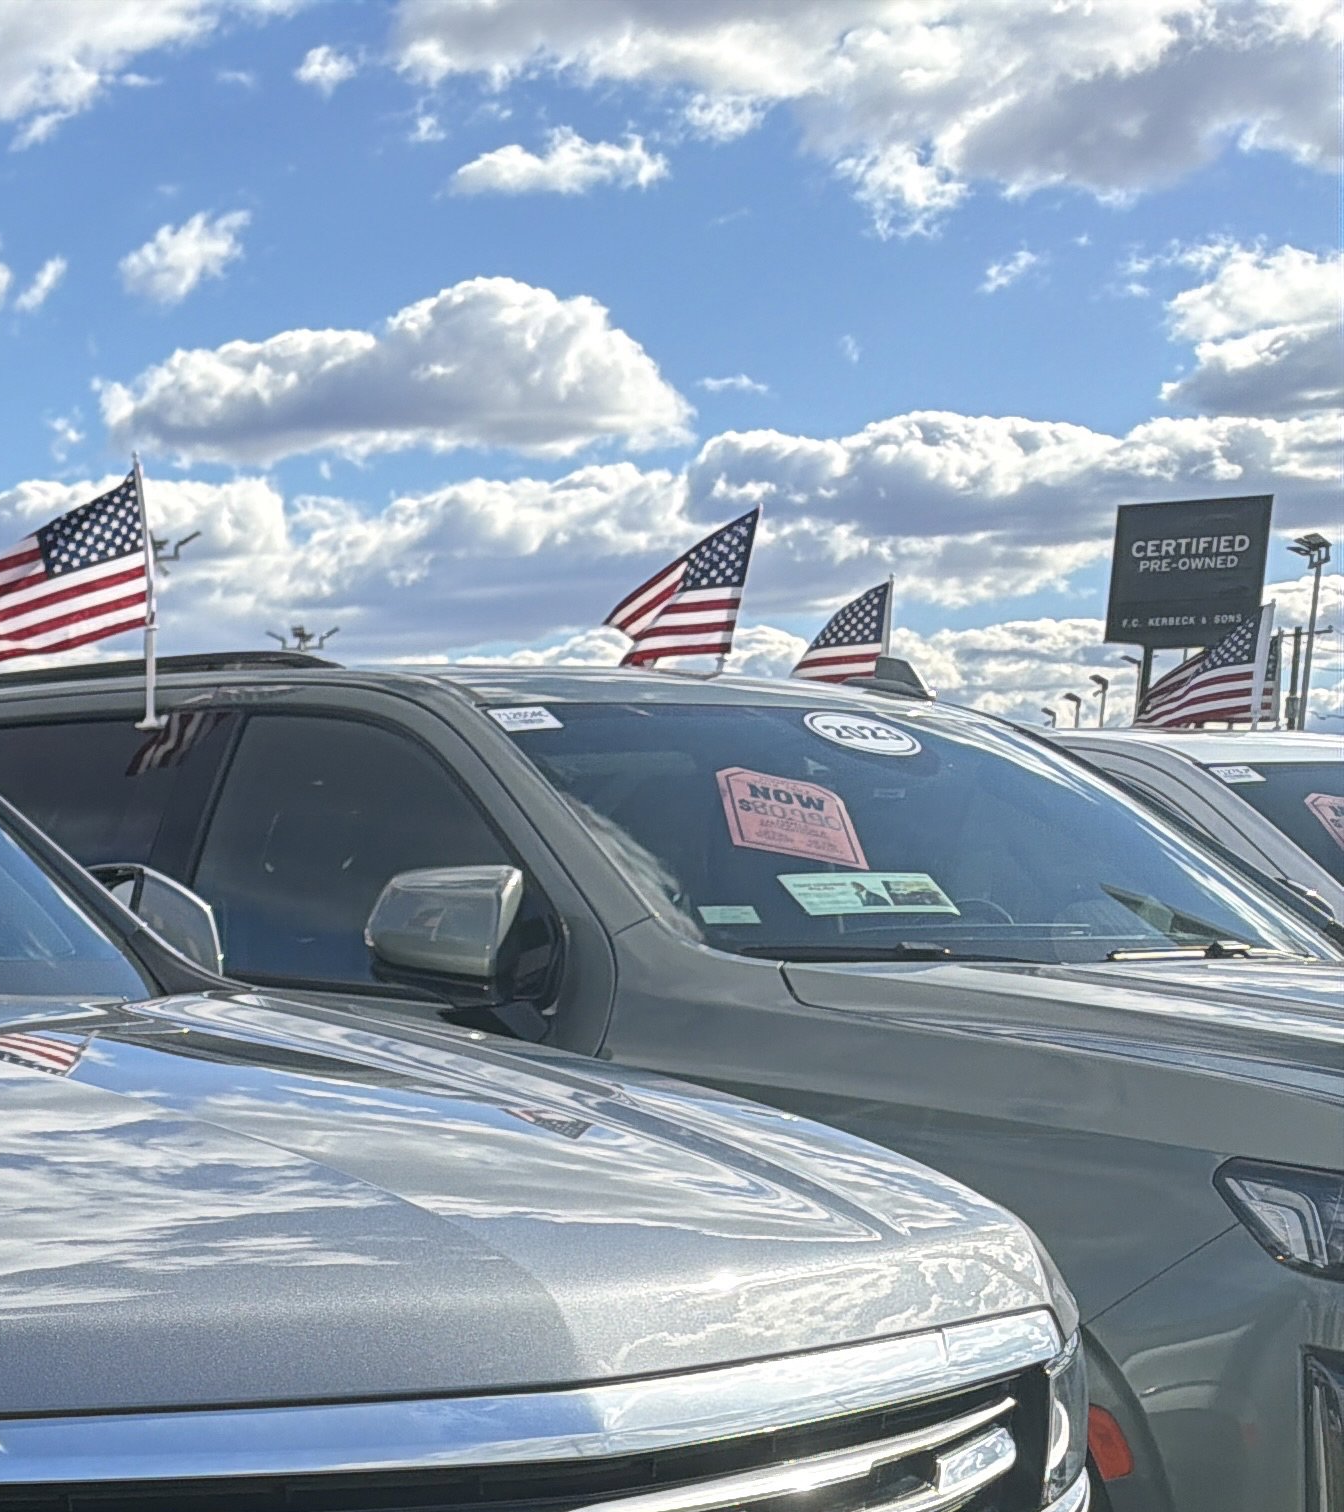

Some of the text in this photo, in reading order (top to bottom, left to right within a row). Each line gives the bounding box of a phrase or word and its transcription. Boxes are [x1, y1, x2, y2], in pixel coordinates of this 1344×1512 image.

[1131, 535, 1250, 557] CERTIFIED
[1139, 555, 1238, 572] PRE-OWNED
[1148, 615, 1195, 627] KERBECK
[1214, 614, 1242, 624] SONS
[748, 784, 824, 811] NOW
